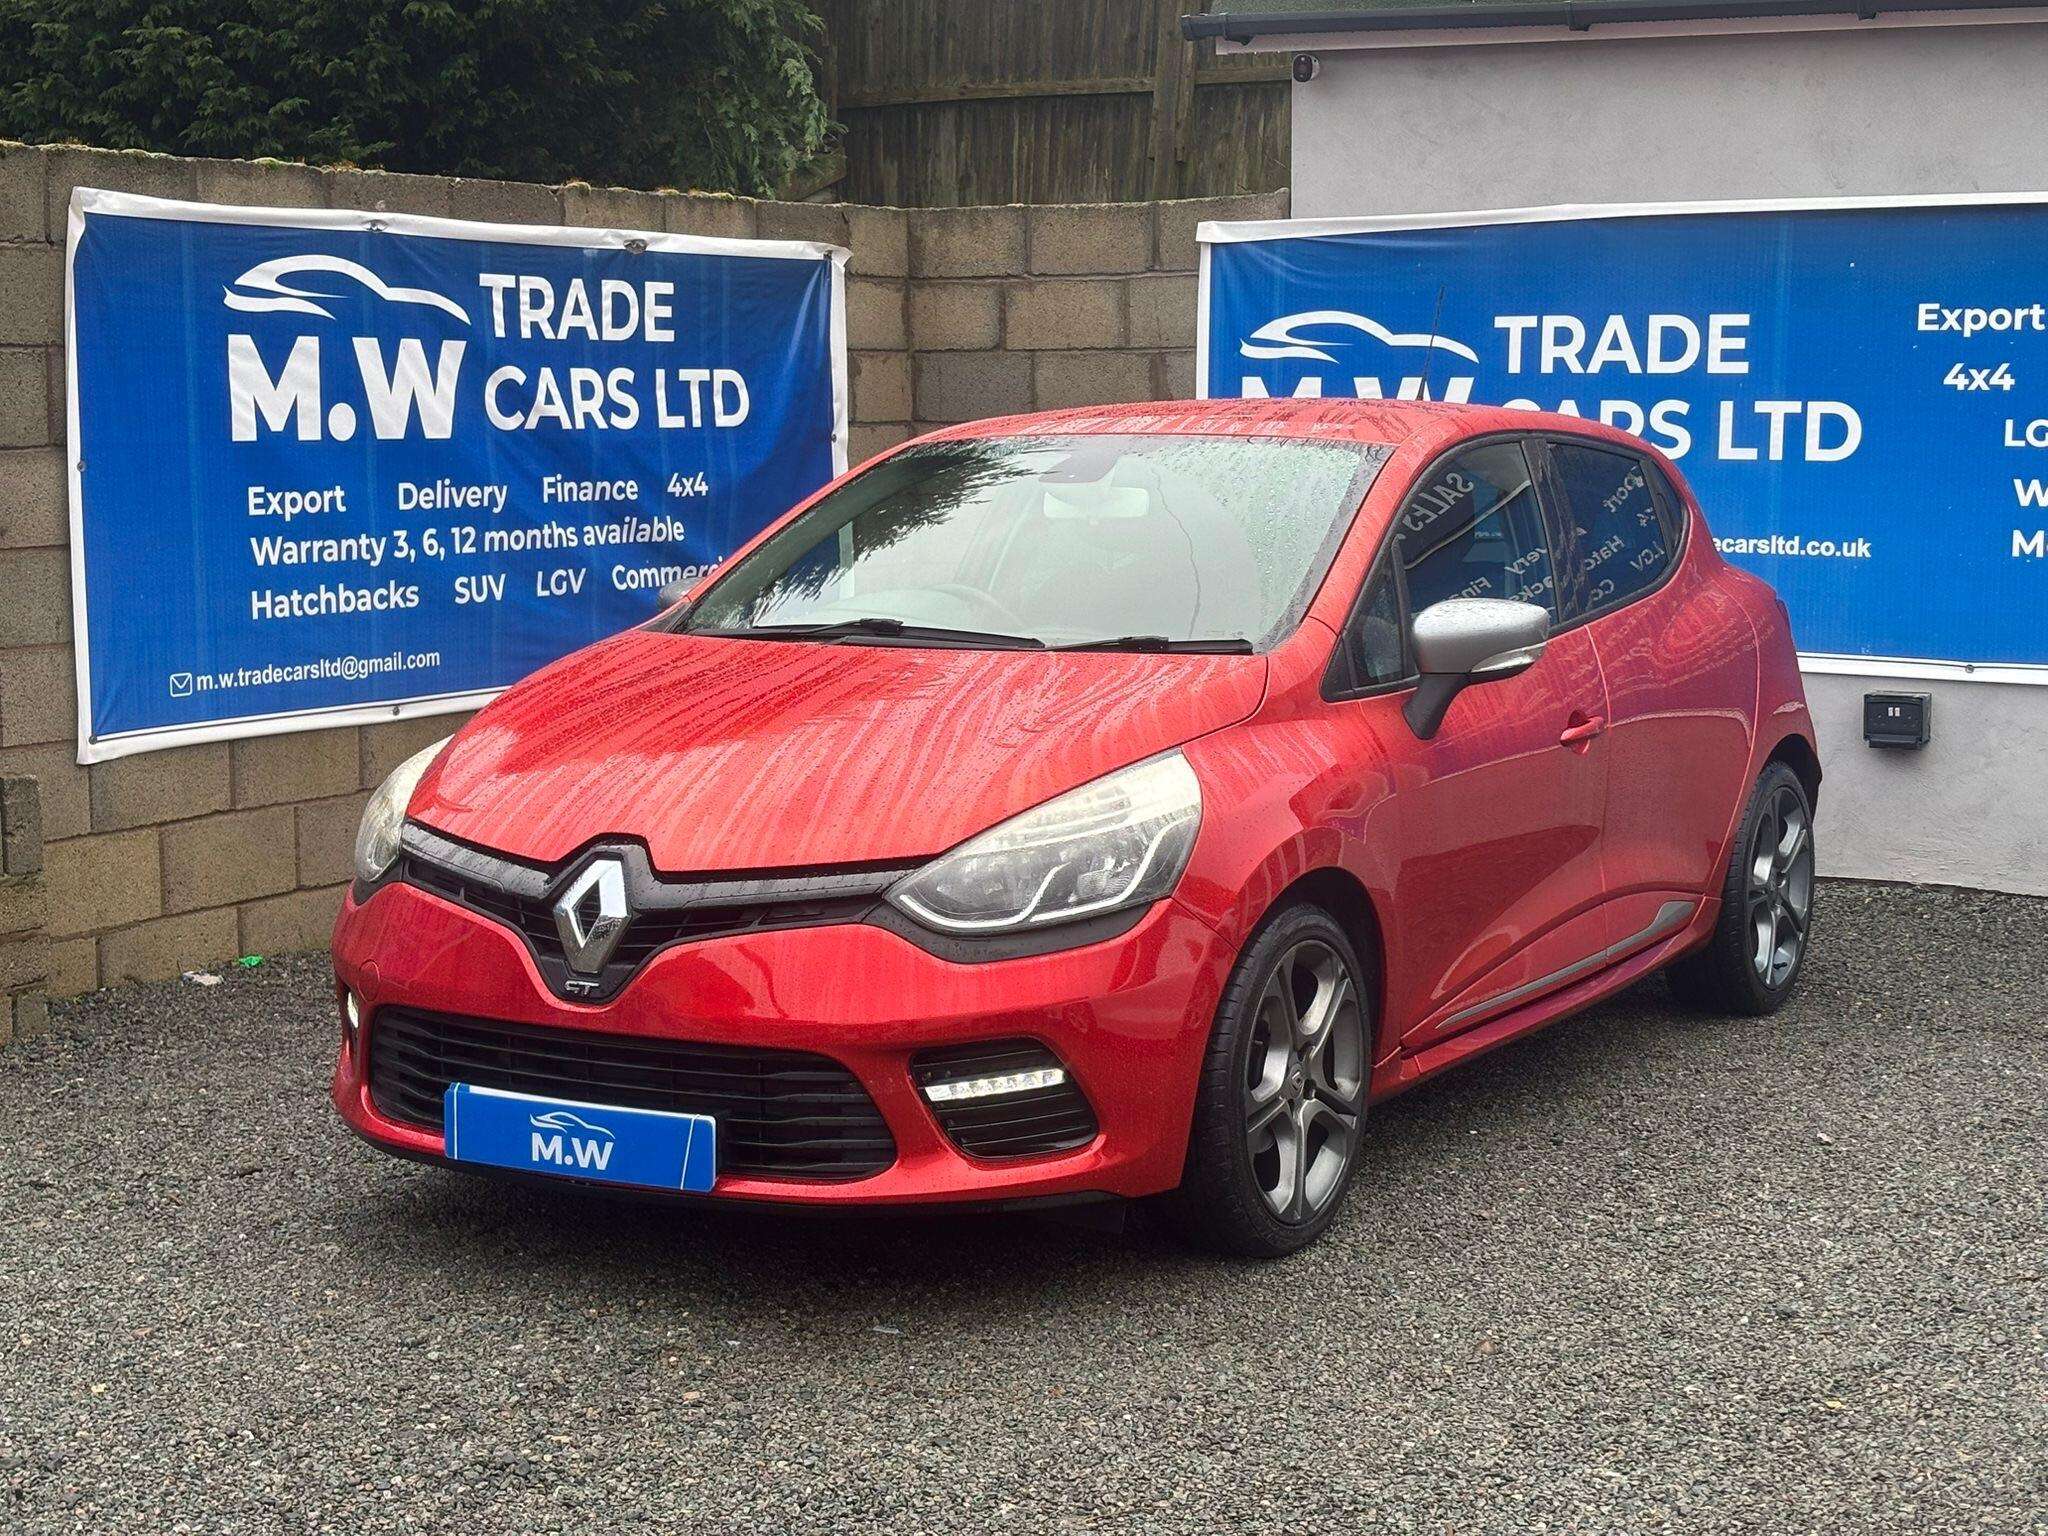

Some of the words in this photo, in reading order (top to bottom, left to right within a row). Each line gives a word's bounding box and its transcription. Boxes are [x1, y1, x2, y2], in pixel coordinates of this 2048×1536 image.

[479, 273, 674, 342] TRADE
[1918, 303, 2046, 337] Export
[1494, 314, 1750, 374] TRADE
[228, 334, 466, 441] M.W
[485, 366, 640, 430] CARS
[656, 369, 749, 429] LTD
[1943, 363, 2016, 391] 4x4
[1718, 400, 1862, 461] LTD
[248, 485, 346, 521] Export
[398, 479, 508, 513] Delivery
[543, 474, 639, 504] Finance
[667, 472, 709, 498] 4x4
[251, 533, 387, 567] Warranty
[394, 530, 416, 562] 3,
[423, 528, 446, 560] 6,
[451, 526, 477, 555] 12
[484, 520, 579, 552] months
[583, 516, 685, 547] available
[251, 580, 420, 620] Hatchbacks
[454, 573, 506, 604] SUV
[537, 568, 587, 597] LGV
[611, 555, 723, 591] Commerc
[196, 651, 440, 691] m.w.tradecarsltd@gmail.com
[564, 980, 600, 996] GT
[531, 1132, 614, 1171] M.W
